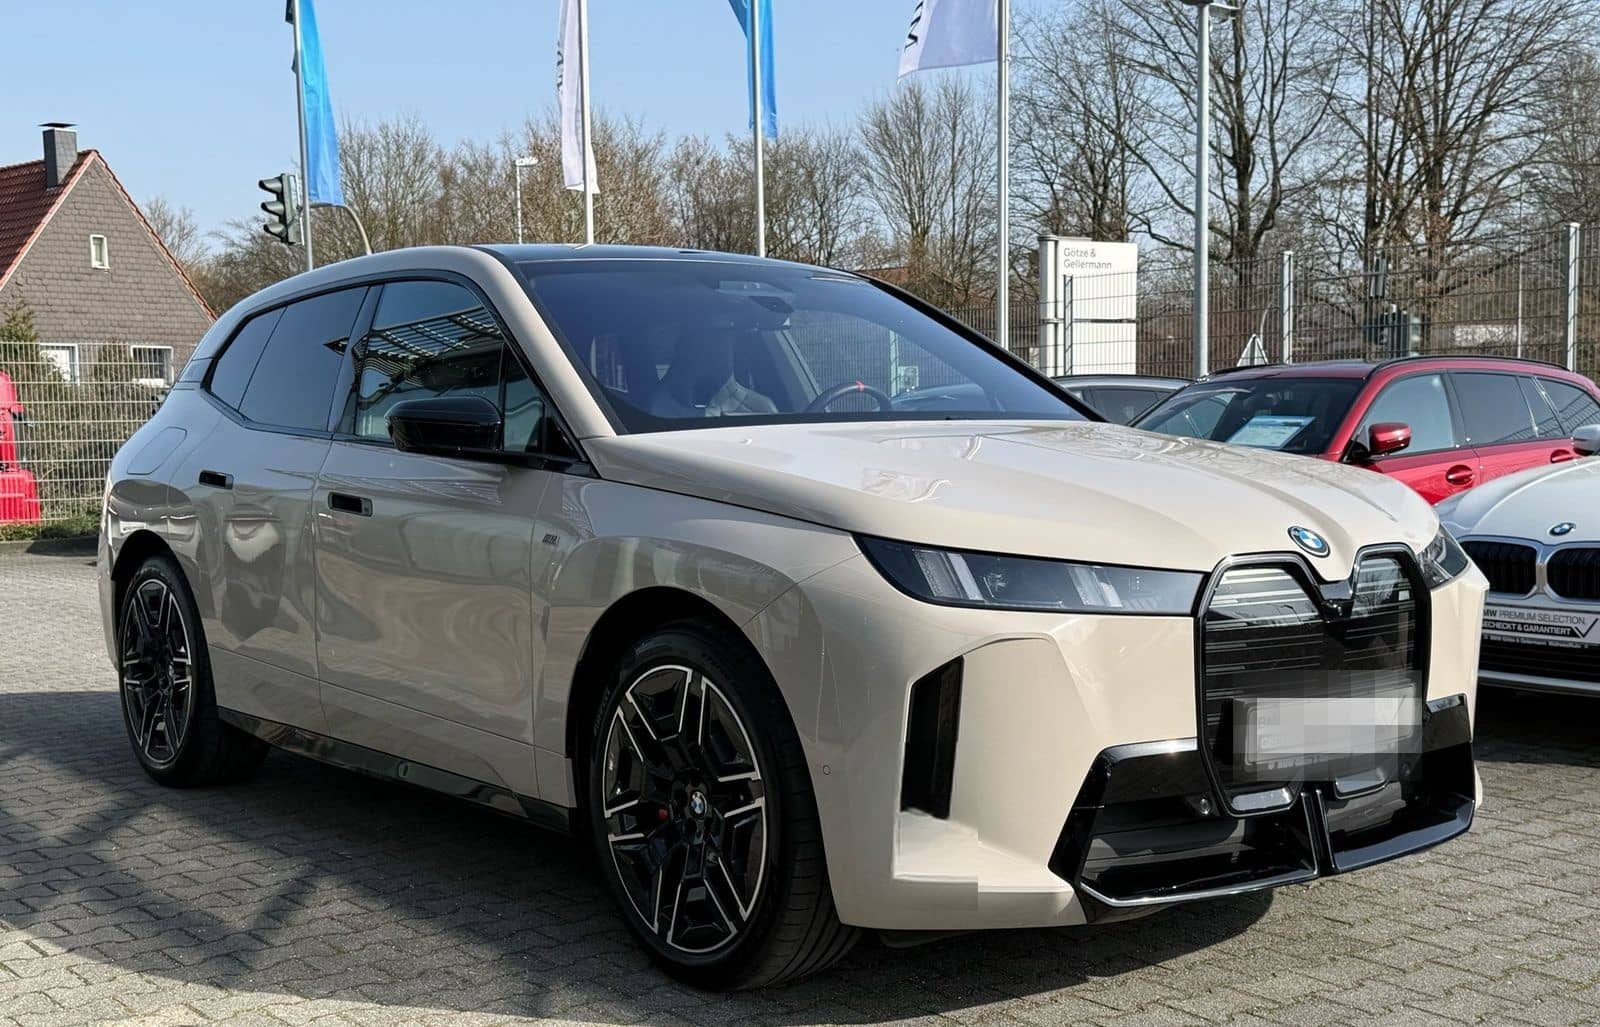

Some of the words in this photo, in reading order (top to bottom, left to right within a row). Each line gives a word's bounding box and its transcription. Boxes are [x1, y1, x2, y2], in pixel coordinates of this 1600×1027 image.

[1063, 247, 1089, 258] Götze
[1090, 248, 1096, 257] &
[1063, 259, 1112, 269] Gellermann
[1483, 609, 1497, 618] MW
[1499, 611, 1537, 621] PREMIUM
[1537, 613, 1585, 624] SELECTION
[1523, 624, 1571, 636] GARANTIERT
